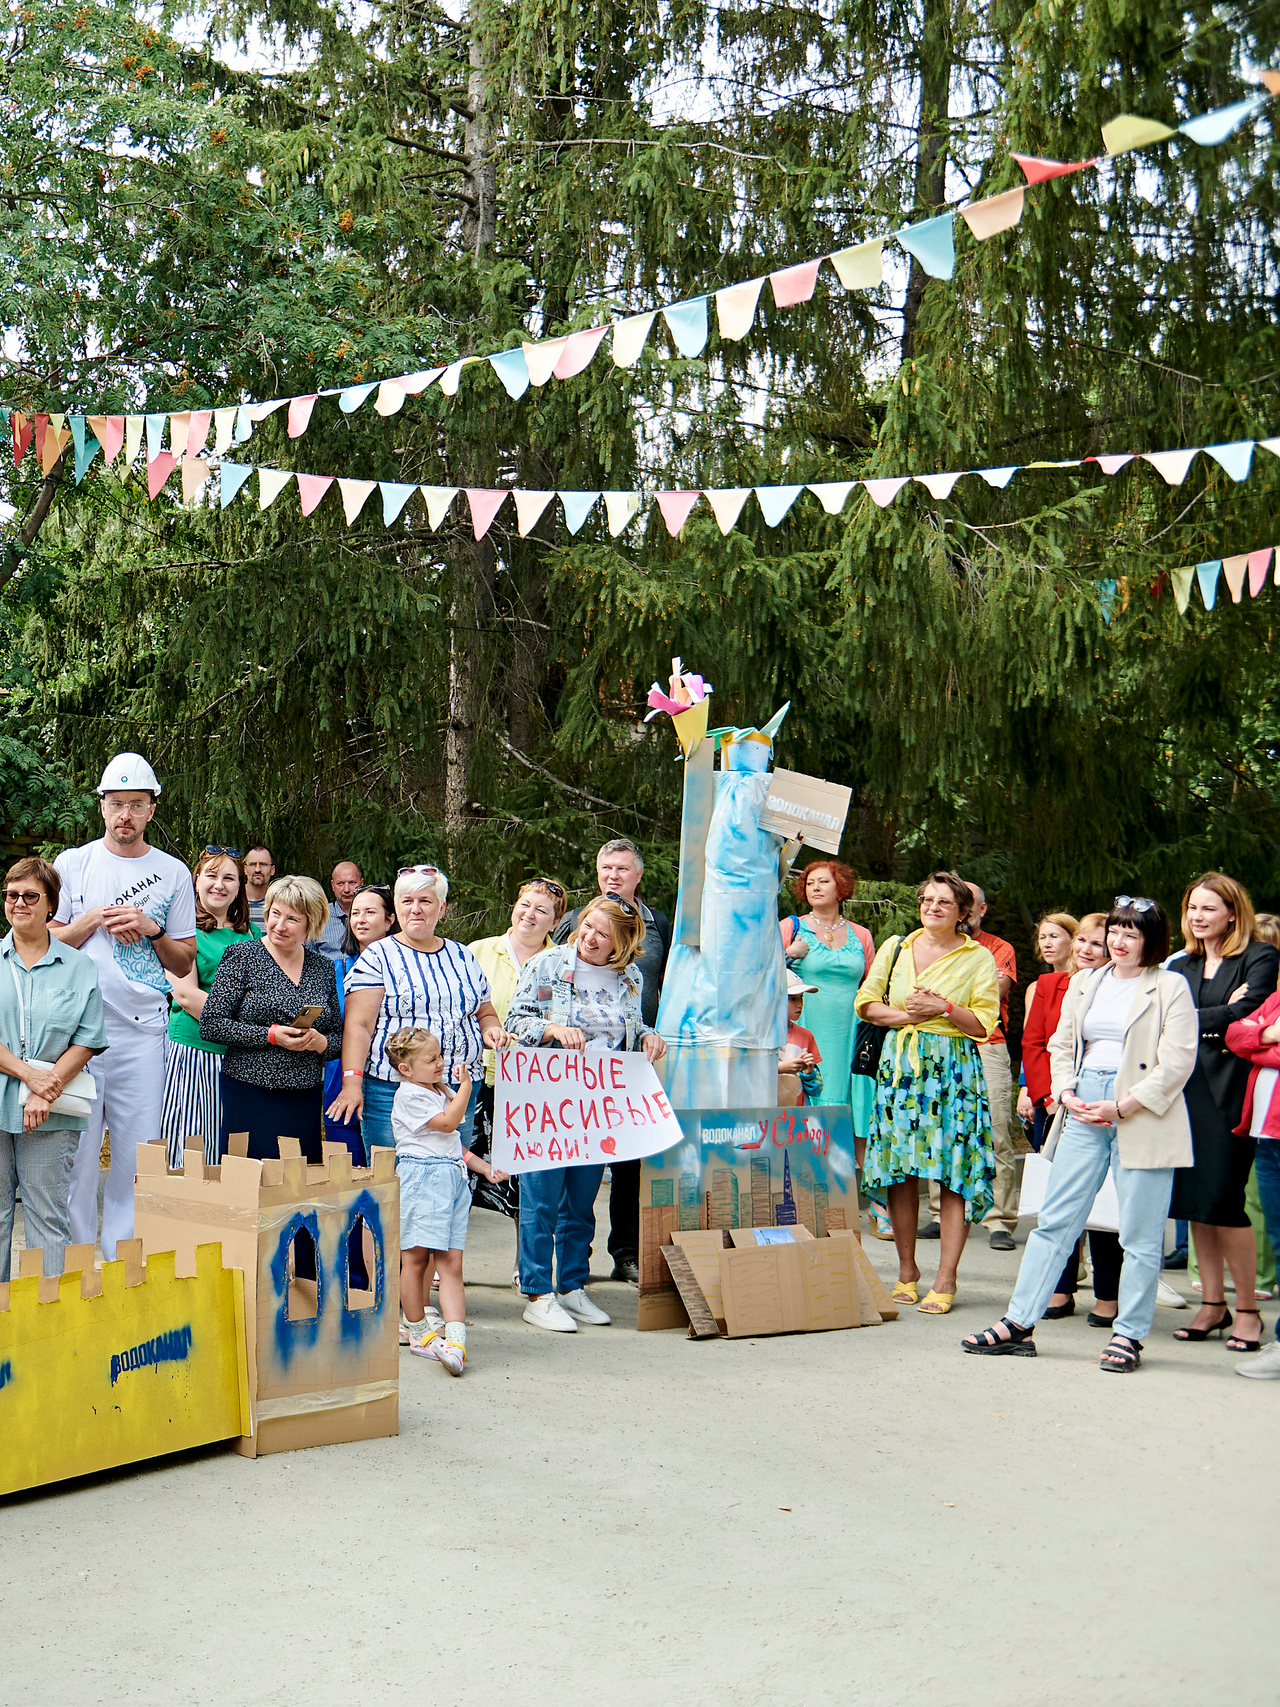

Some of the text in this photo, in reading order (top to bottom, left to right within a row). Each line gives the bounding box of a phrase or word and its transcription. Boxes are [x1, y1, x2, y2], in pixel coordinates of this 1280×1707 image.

[110, 873, 162, 906] ОКАНАЛ
[501, 1050, 626, 1090] КРАСНЫЕ
[505, 1090, 672, 1139] КРАСИВЫЕ
